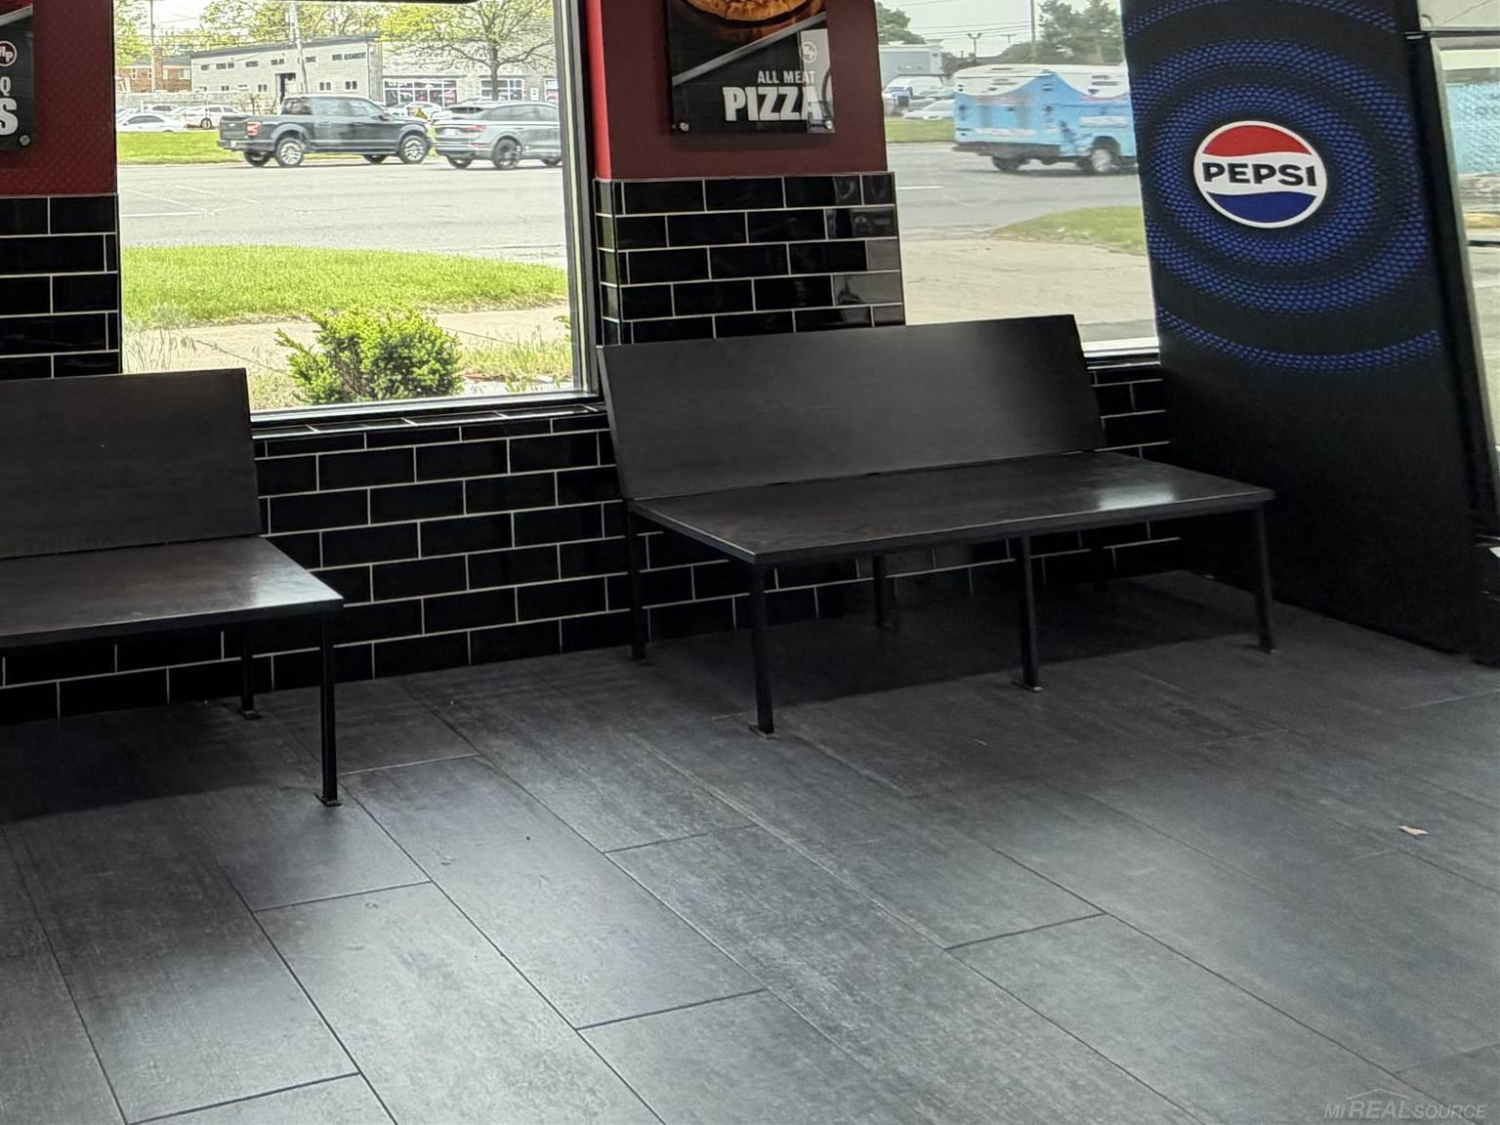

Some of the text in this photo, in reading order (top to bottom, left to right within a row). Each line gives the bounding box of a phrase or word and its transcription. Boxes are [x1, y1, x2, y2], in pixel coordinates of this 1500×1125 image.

[757, 71, 815, 84] ALL MEAT
[722, 86, 823, 121] PIZZA
[1202, 162, 1317, 187] PEPSI
